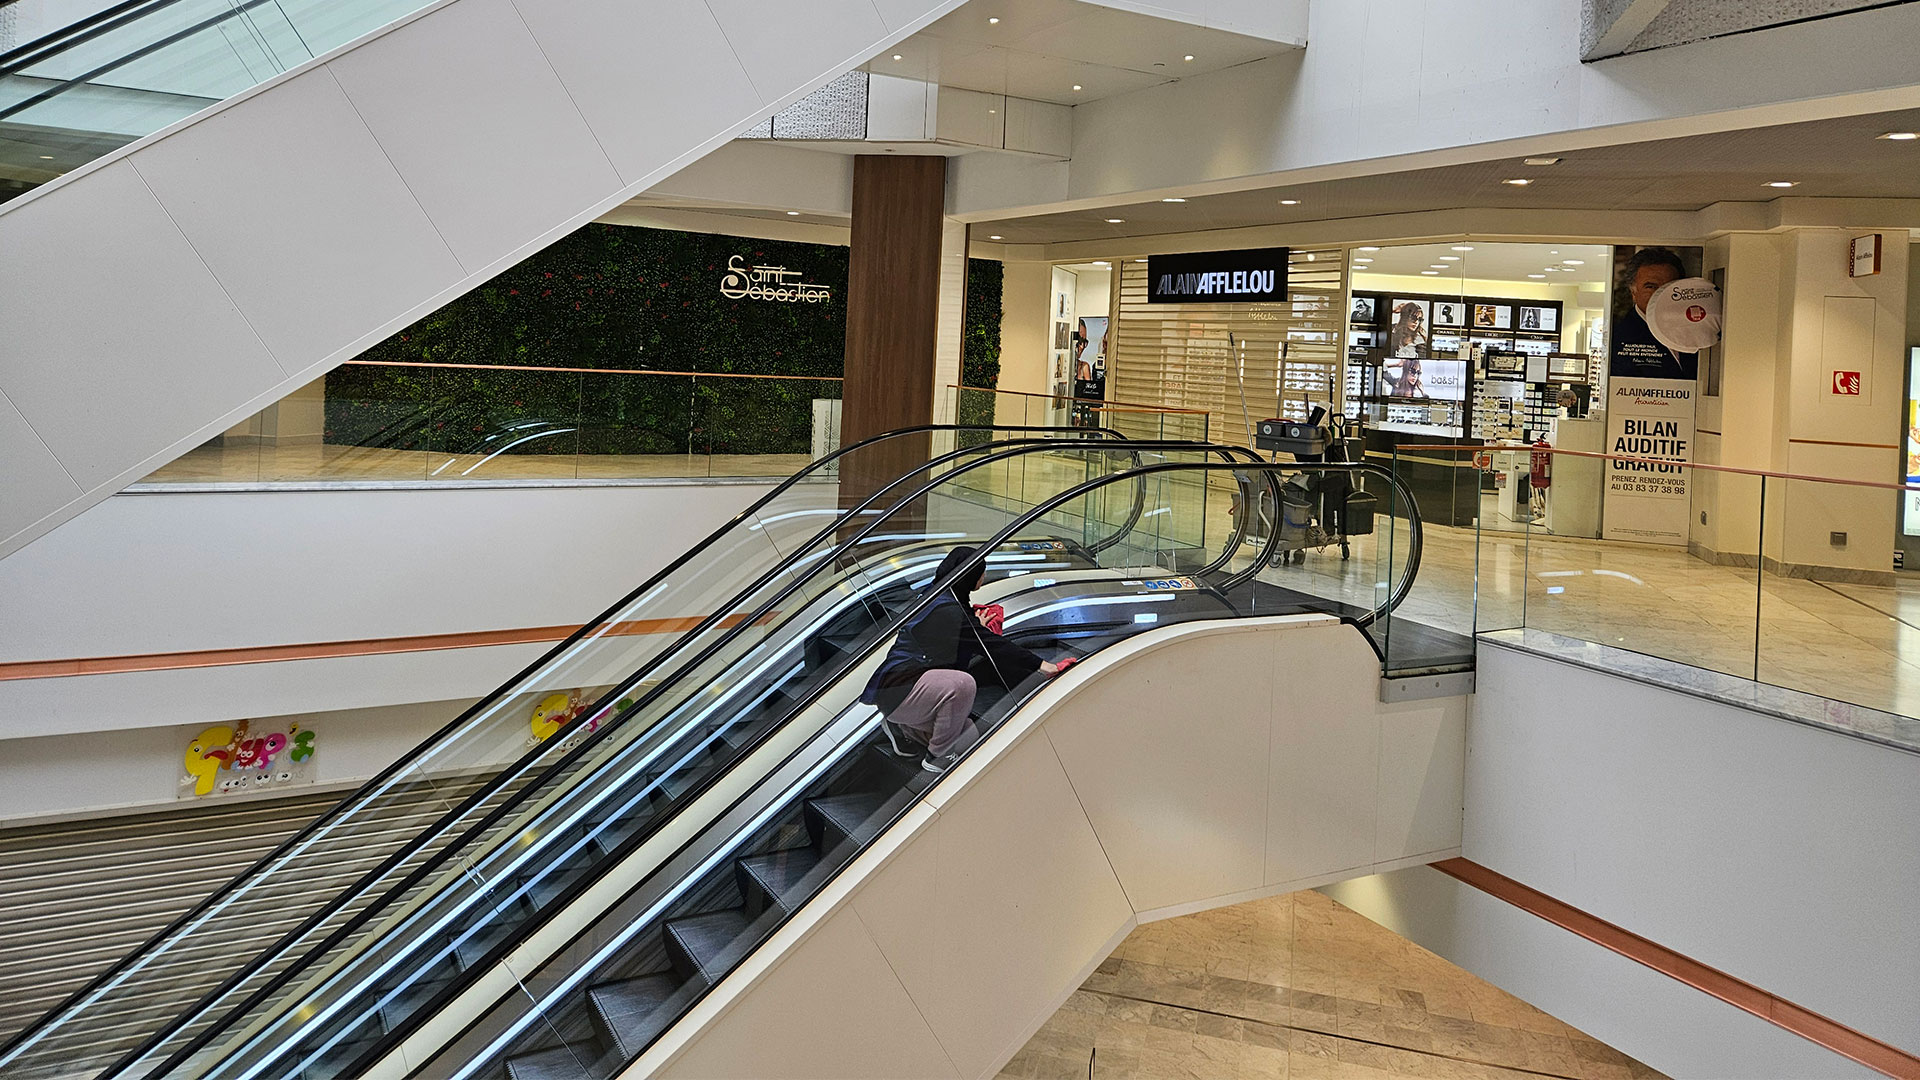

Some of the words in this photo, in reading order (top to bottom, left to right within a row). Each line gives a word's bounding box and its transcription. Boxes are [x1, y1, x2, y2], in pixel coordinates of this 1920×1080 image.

[1431, 375, 1458, 385] ba&sh
[1624, 419, 1678, 437] BILAN
[1614, 437, 1687, 456] AUDITIF
[1611, 475, 1637, 483] PRENEZ
[1639, 476, 1686, 486] RENDEZ-VOUS
[1622, 483, 1633, 491] 03
[1635, 484, 1646, 492] 83
[1648, 485, 1659, 493] 37
[1661, 486, 1672, 494] 38
[1674, 487, 1685, 495] 98
